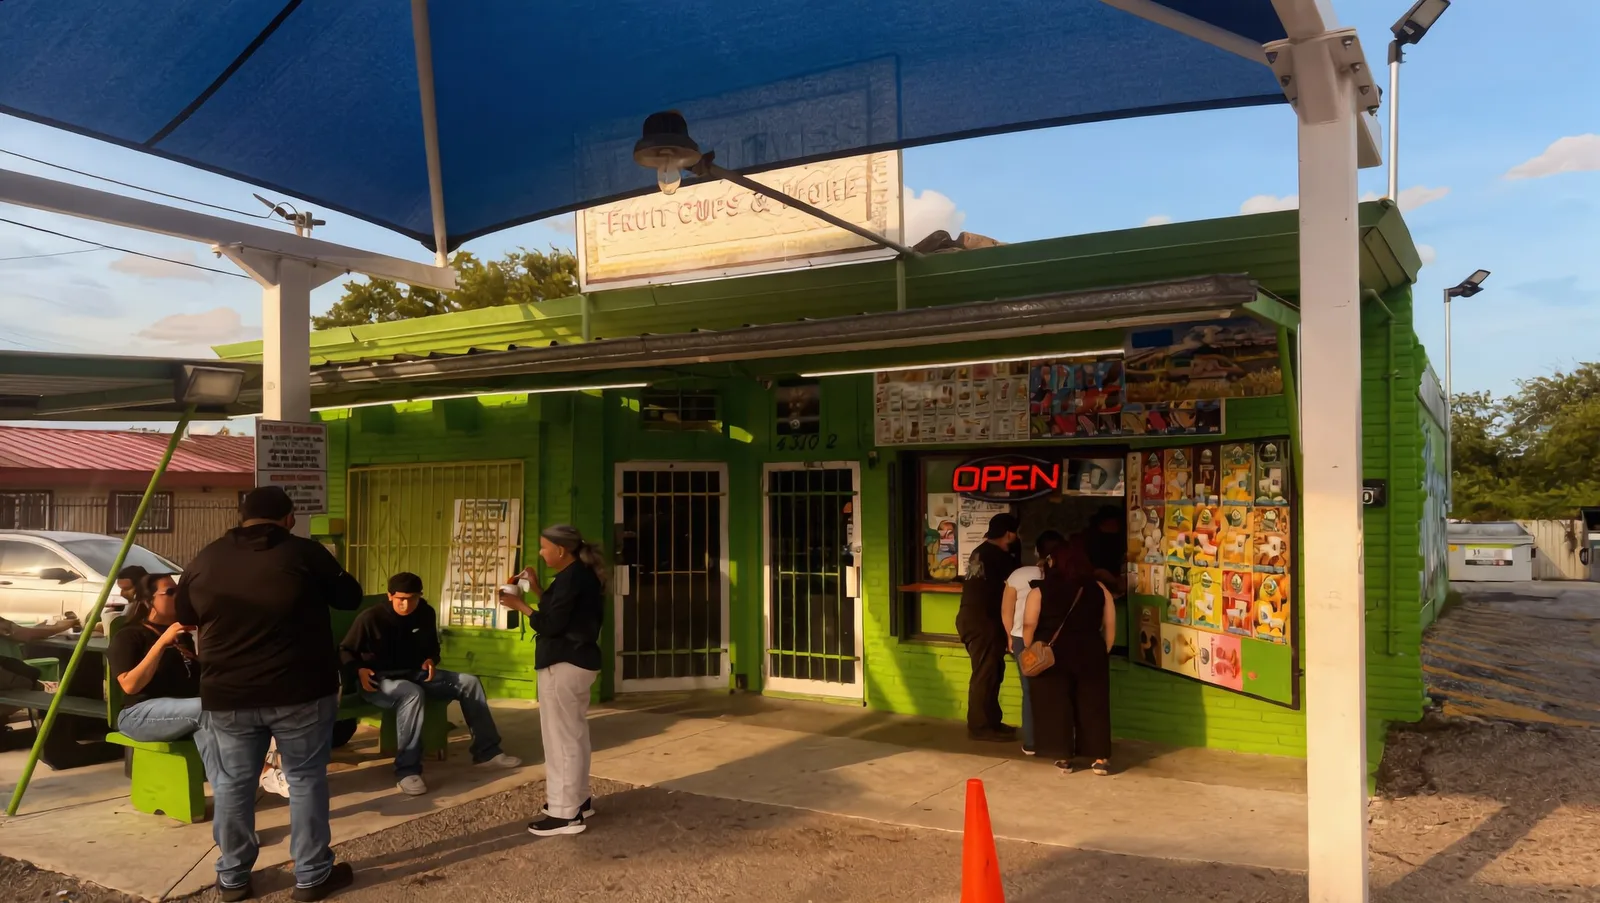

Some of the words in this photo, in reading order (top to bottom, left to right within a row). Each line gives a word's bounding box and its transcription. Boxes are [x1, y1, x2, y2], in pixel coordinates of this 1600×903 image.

[607, 206, 668, 235] FRUIT
[678, 196, 739, 224] CUPS
[953, 463, 1060, 492] OPEN
